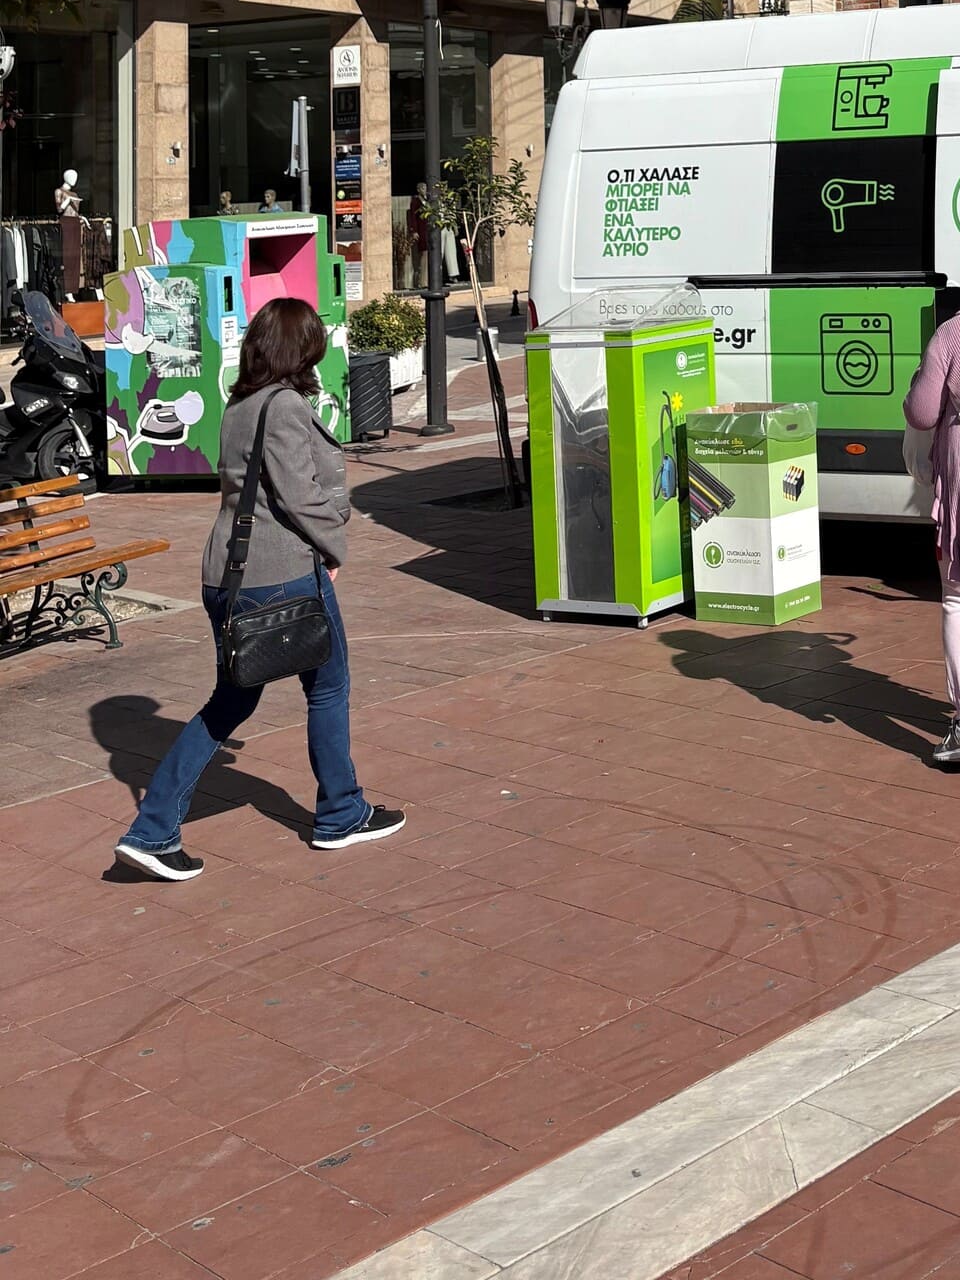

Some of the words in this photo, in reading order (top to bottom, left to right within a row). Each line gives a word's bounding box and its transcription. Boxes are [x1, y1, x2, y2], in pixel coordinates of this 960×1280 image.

[607, 169, 635, 184] Ο,ΤΙ
[638, 166, 700, 182] ΧΑΛΑΣΕ
[606, 182, 663, 197] ΜΠΟΡΕΙ
[667, 181, 691, 196] ΝΑ
[605, 197, 659, 212] ΦΤΙΑΞΕΙ
[604, 213, 634, 227] ΕΝΑ
[603, 226, 681, 242] ΚΑΛΥΤΕΡΟ
[602, 242, 649, 257] ΑΥΡΙΟ
[711, 305, 734, 316] στο
